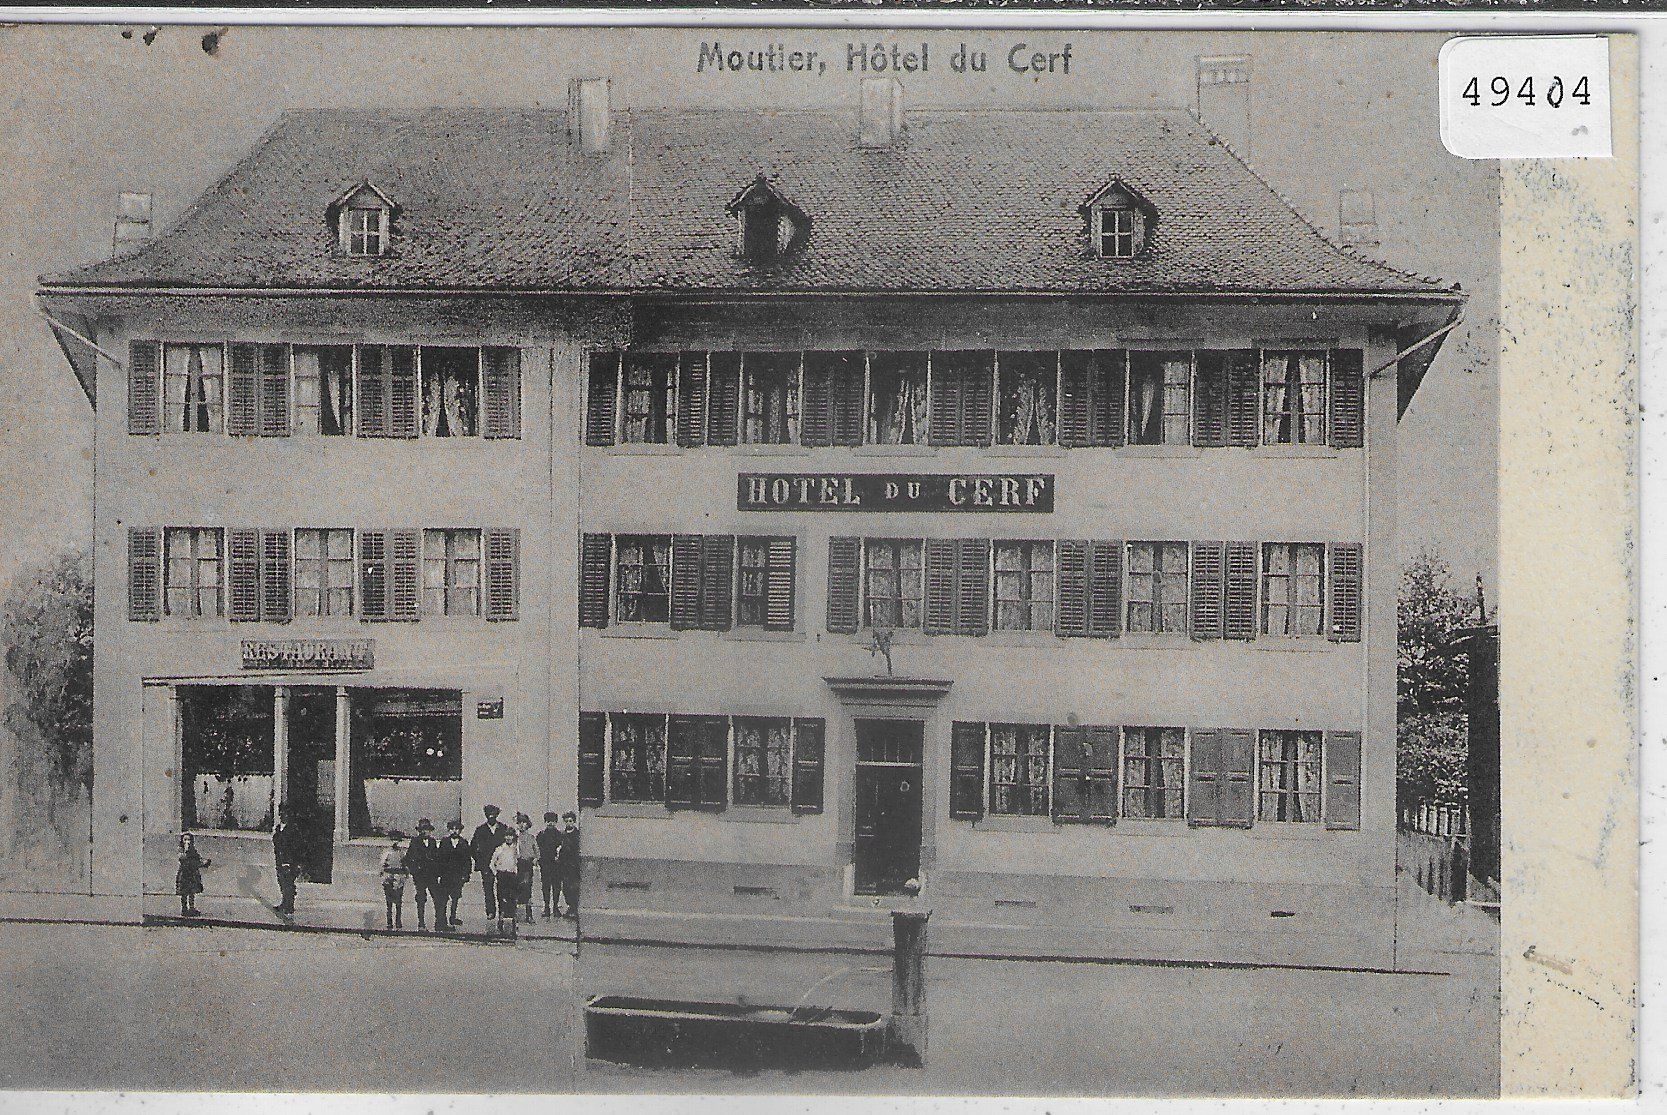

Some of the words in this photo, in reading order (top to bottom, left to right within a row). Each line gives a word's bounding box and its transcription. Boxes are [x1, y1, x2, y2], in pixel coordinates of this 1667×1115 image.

[1462, 75, 1591, 108] 49404
[747, 477, 861, 505] HOTEL
[885, 482, 921, 500] DU
[948, 478, 1045, 506] CERF
[242, 640, 369, 661] RESTAURANT
